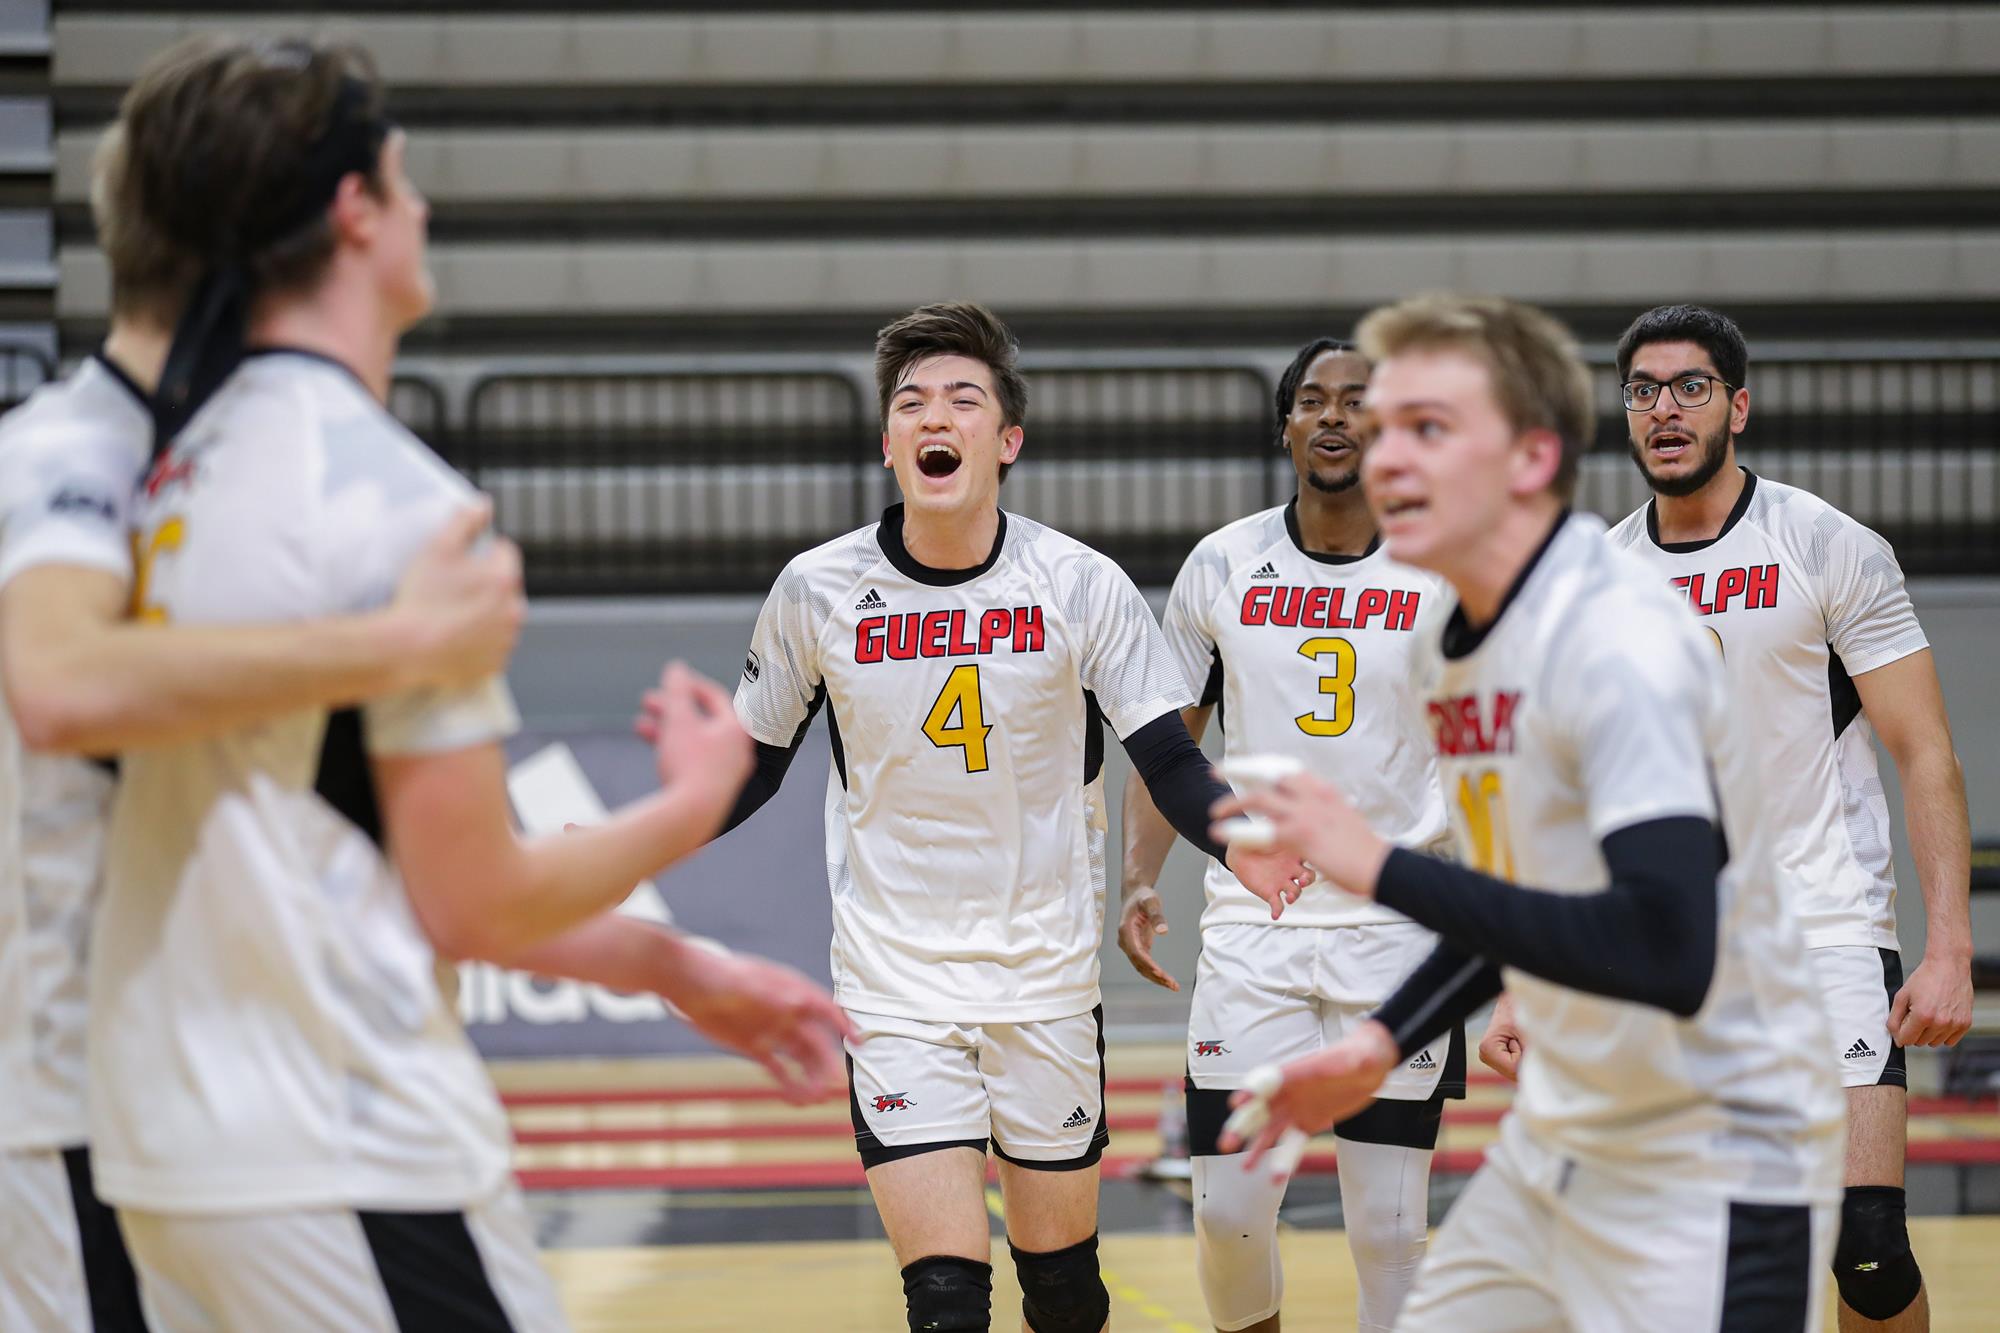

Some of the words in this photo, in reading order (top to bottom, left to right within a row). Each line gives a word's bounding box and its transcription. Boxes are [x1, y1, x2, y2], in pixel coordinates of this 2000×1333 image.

[1251, 572, 1280, 580] adidas
[855, 600, 887, 611] adidas
[1240, 586, 1421, 631] GUELPH
[854, 605, 1045, 664] GUELPH
[1294, 637, 1357, 737] 3
[921, 664, 993, 774] 4
[1844, 1050, 1877, 1059] adidas
[1409, 1061, 1437, 1069] adidas
[1062, 1116, 1091, 1128] adidas
